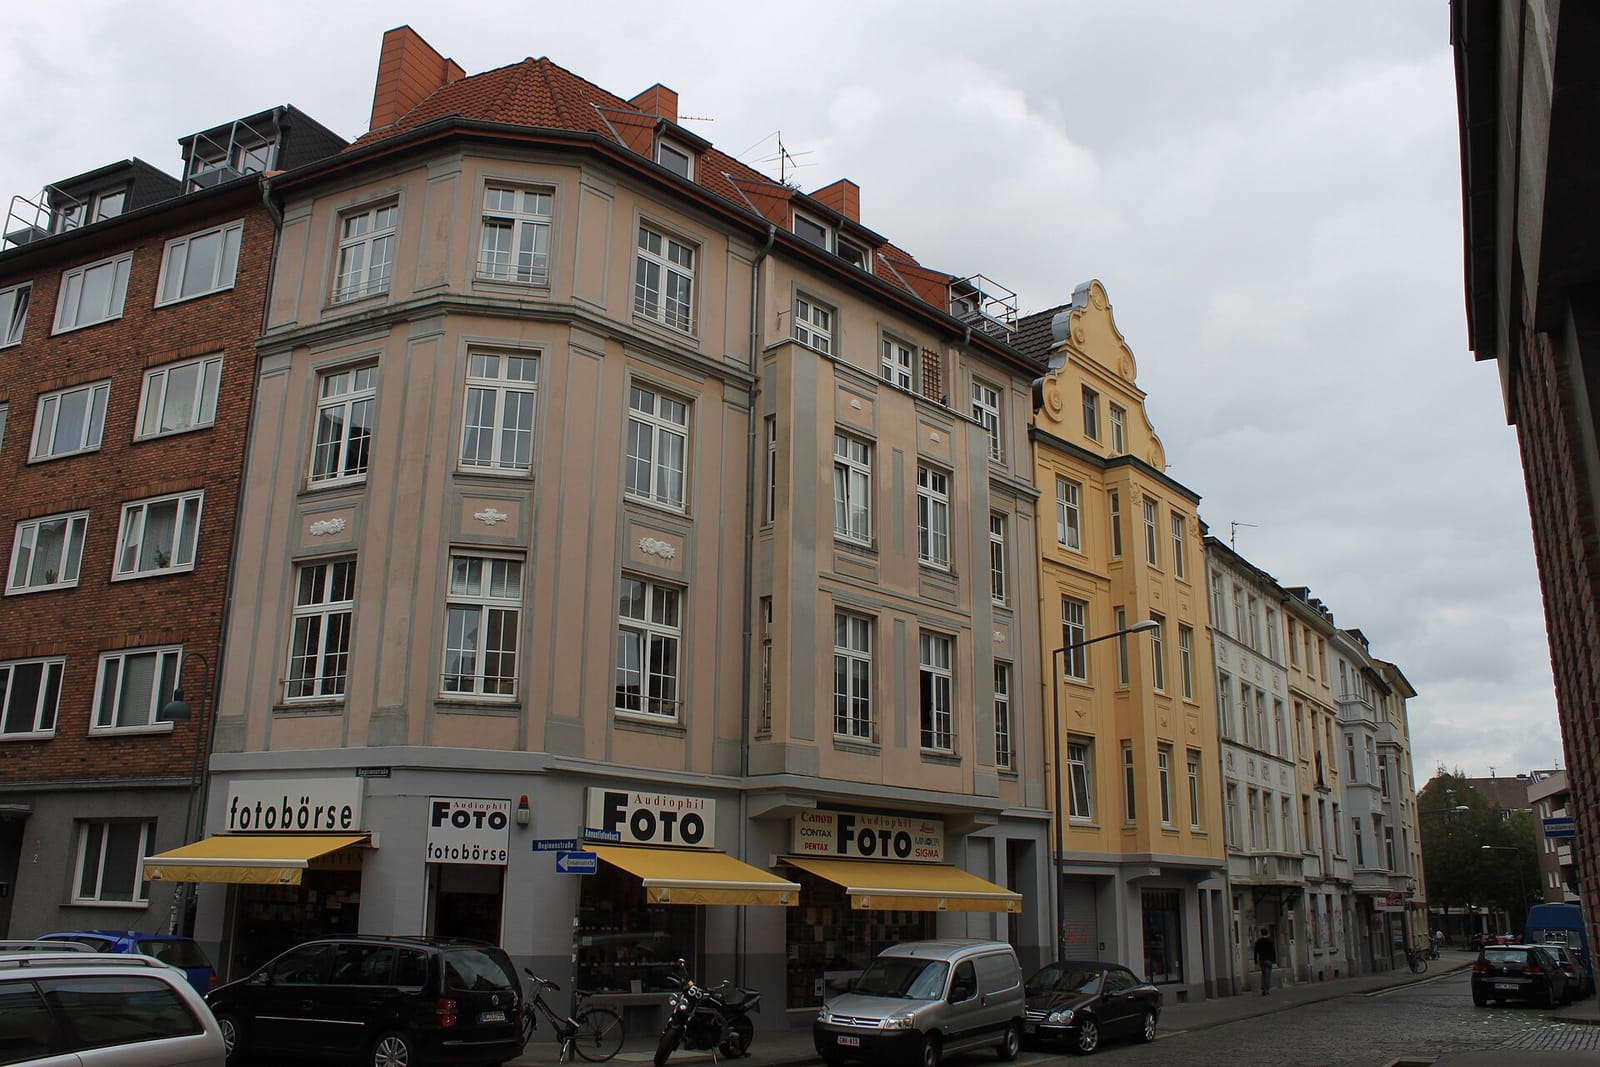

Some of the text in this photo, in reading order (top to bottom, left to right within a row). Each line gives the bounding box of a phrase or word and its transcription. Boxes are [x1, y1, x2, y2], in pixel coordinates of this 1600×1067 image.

[454, 801, 507, 811] Audiophil
[634, 793, 705, 811] Audiophil
[229, 795, 353, 830] fotobörse
[432, 801, 508, 830] FOTO
[603, 791, 705, 845] FOTO
[801, 811, 833, 824] Canon
[859, 815, 912, 828] Audiophil
[800, 827, 832, 838] CONTAX
[837, 814, 912, 858] FOTO
[428, 842, 507, 861] fotobörse
[804, 842, 829, 851] PENTAX
[915, 848, 939, 858] SIGMA
